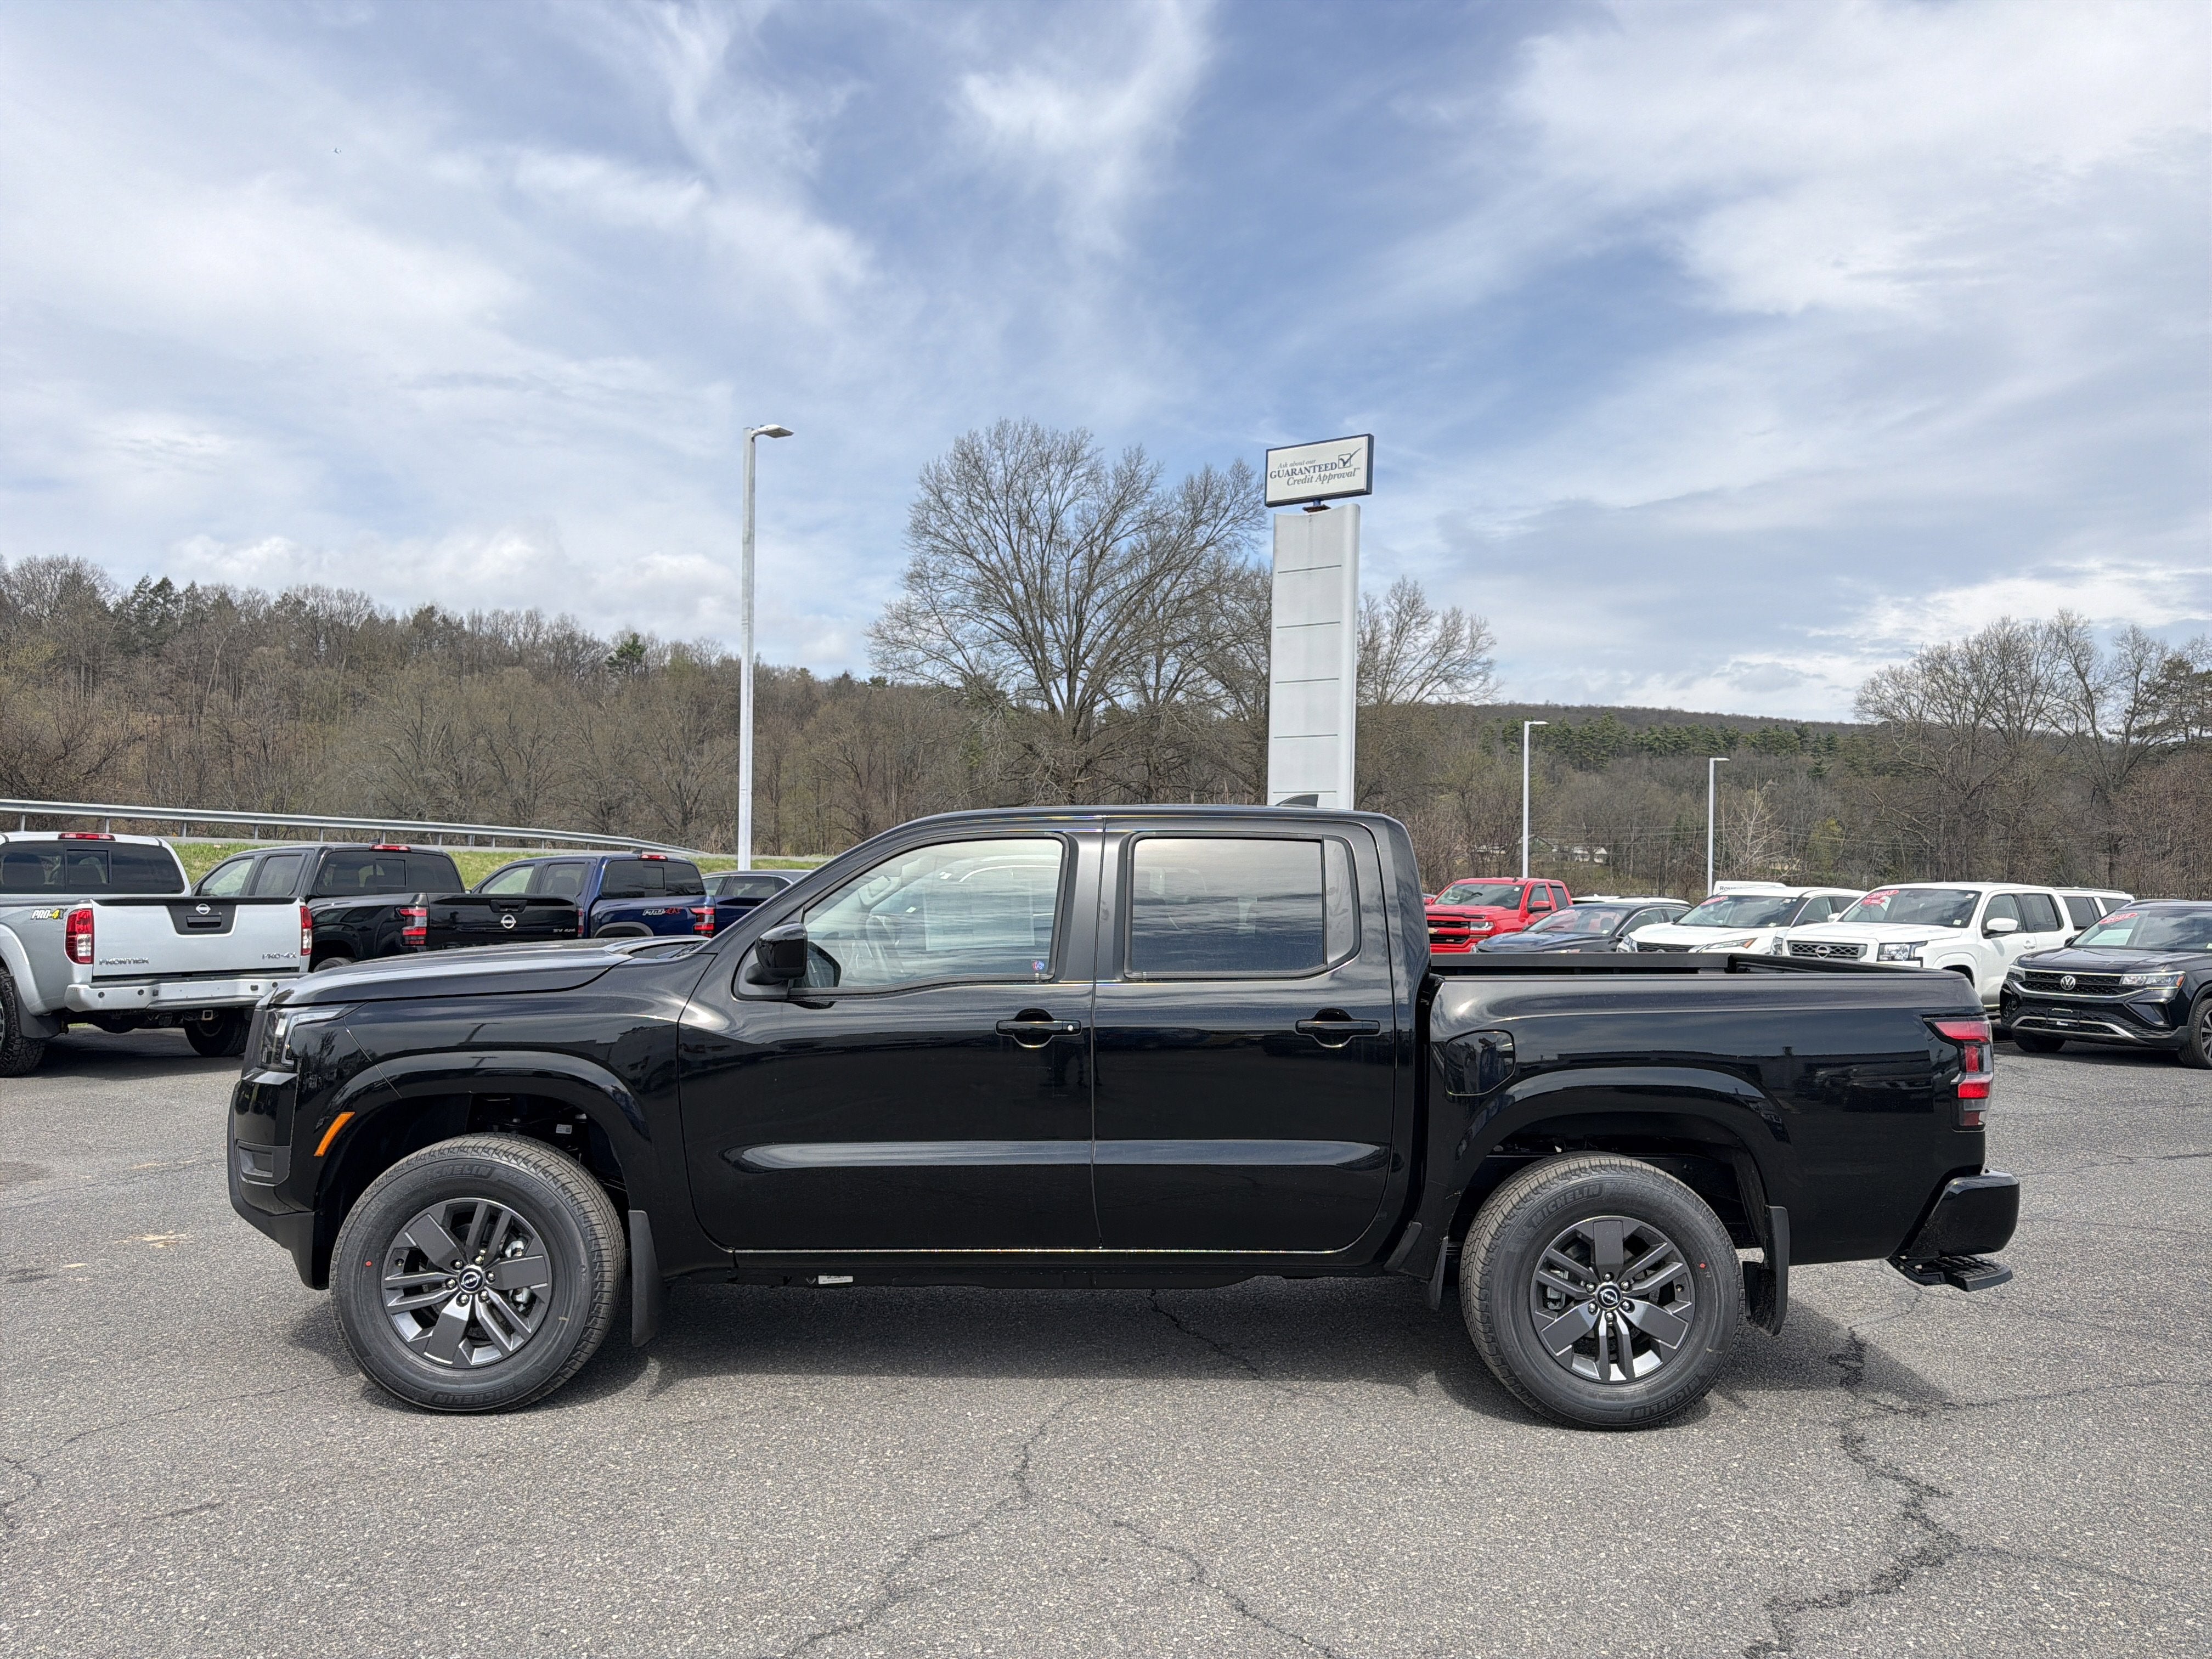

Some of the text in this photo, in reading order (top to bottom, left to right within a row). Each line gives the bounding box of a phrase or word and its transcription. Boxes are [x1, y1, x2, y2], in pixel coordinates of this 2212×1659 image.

[1269, 462, 1337, 479] GUARANTEED
[1286, 475, 1314, 486] Credit
[99, 957, 149, 965] FRONTIER
[1531, 1184, 1601, 1228] MICHELIN
